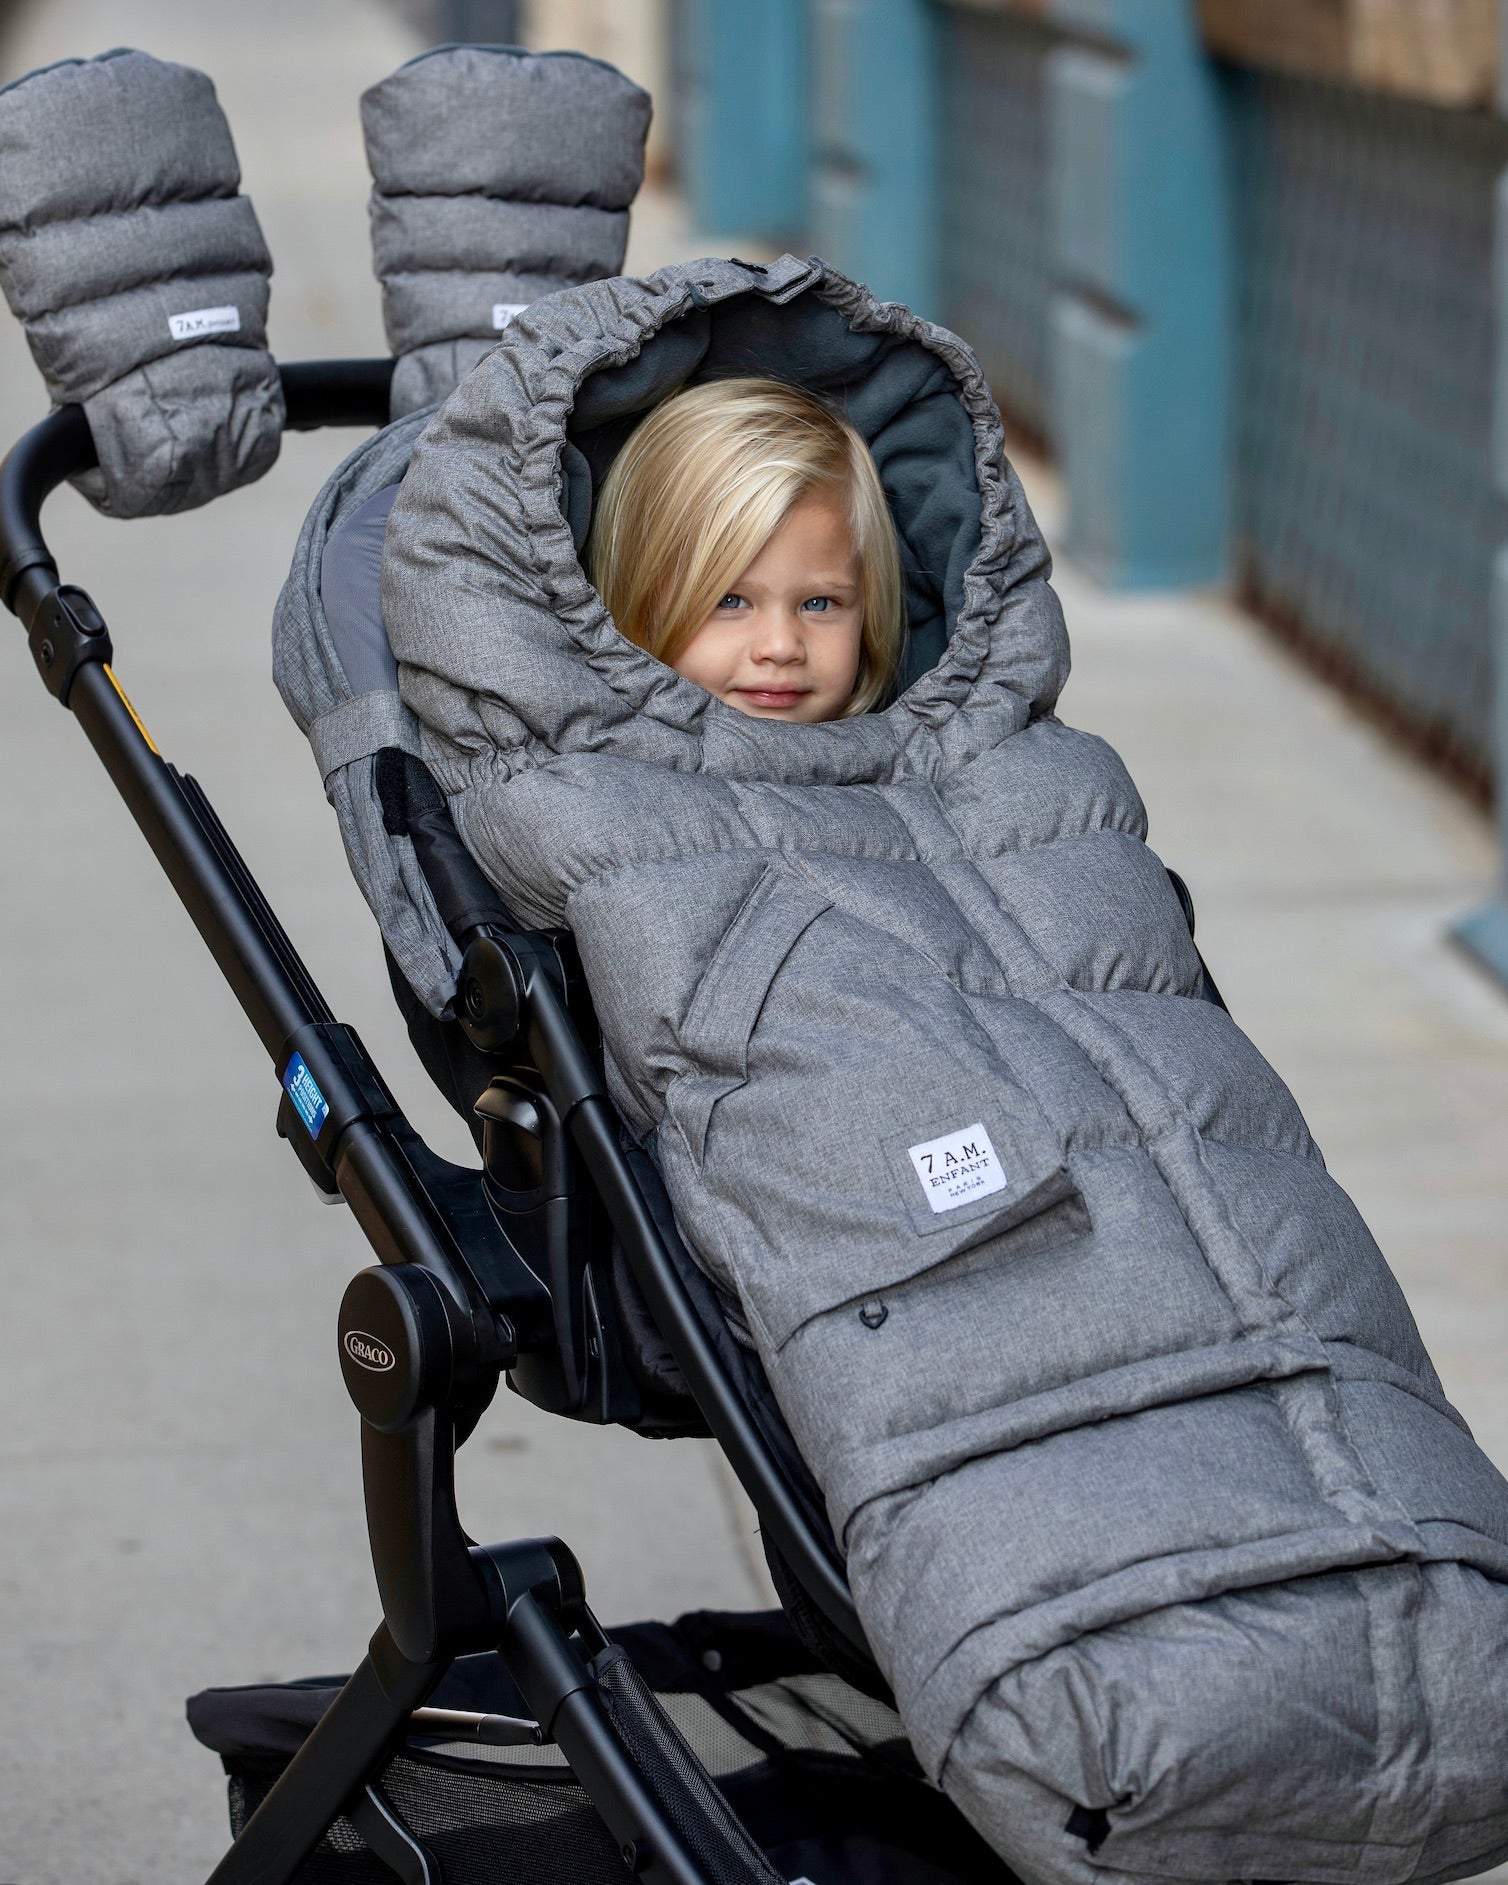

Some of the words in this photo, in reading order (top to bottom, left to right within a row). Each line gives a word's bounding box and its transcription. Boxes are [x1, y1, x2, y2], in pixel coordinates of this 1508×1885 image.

[293, 1064, 305, 1087] 3
[301, 1073, 323, 1109] HEIGHT
[920, 1153, 933, 1174] 7
[944, 1142, 986, 1167] A.M.
[929, 1158, 990, 1187] ENFANT
[350, 1336, 389, 1366] GRACO
